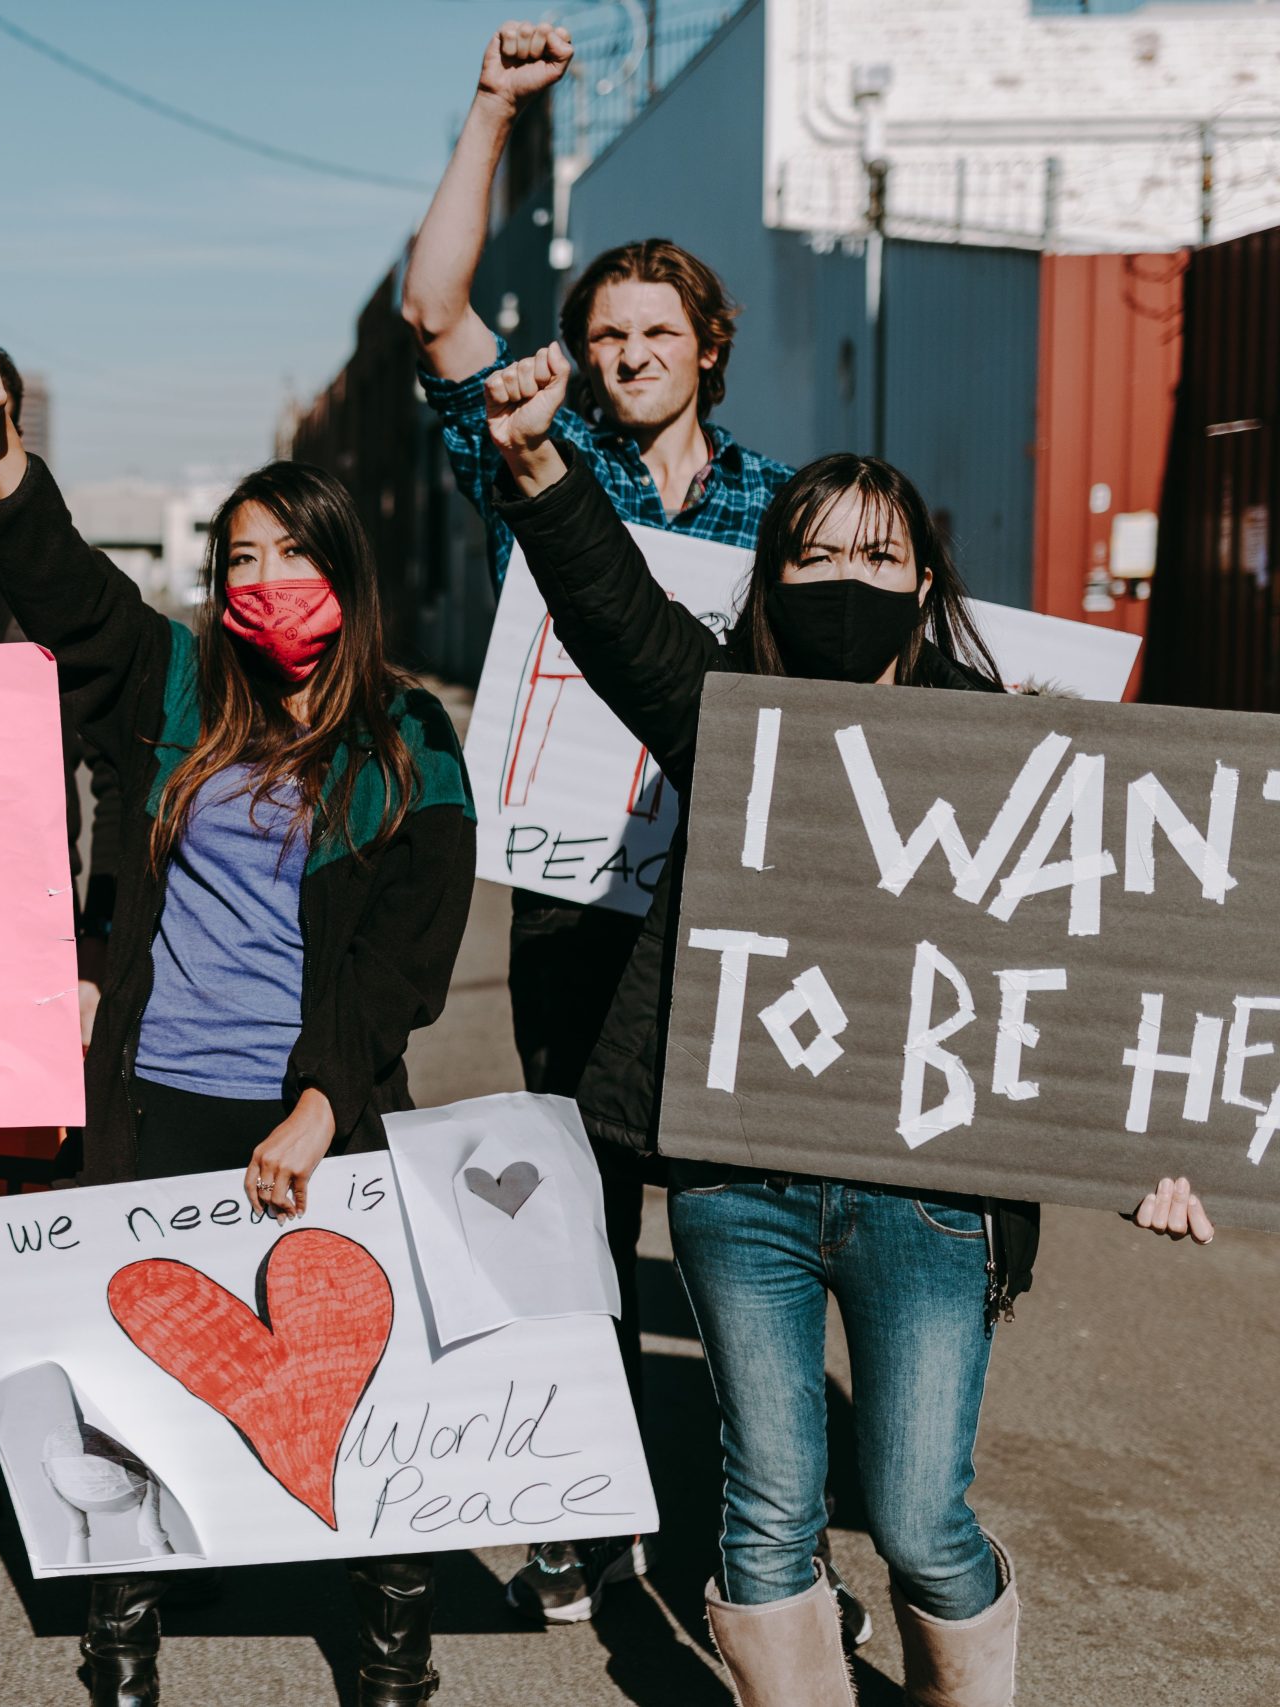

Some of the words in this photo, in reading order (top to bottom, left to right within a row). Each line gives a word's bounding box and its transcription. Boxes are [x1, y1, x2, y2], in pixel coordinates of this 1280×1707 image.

[276, 591, 293, 602] NOT
[741, 707, 782, 873] I
[896, 940, 1067, 1150] BE
[7, 1215, 81, 1254] we
[347, 1174, 386, 1211] is
[344, 1380, 582, 1468] World
[370, 1466, 636, 1538] Peace
